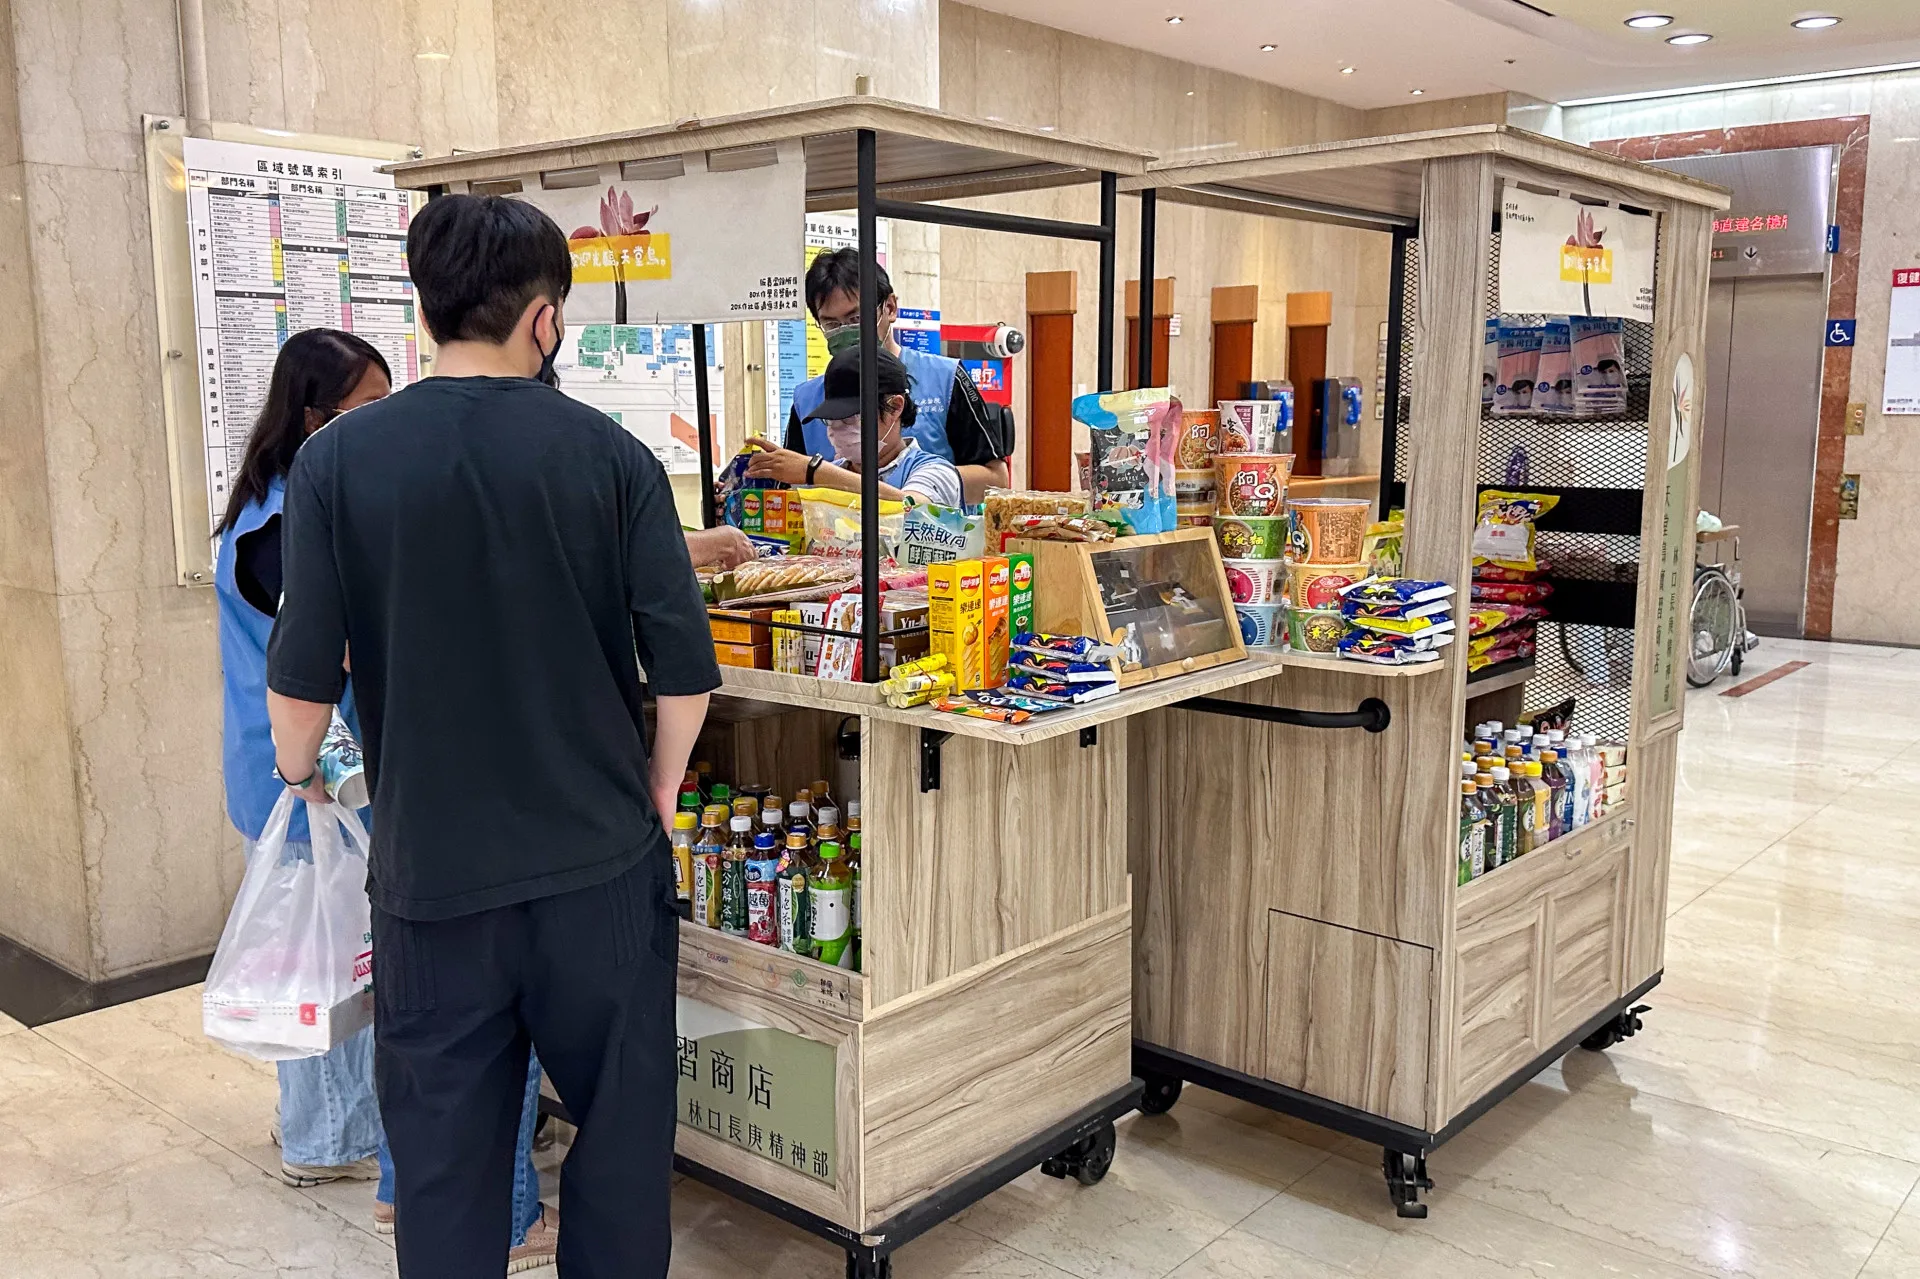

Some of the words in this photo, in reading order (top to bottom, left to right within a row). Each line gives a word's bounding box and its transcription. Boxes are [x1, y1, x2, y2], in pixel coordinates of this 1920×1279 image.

[220, 176, 256, 188] 部門名稱
[257, 160, 343, 180] 區域號碼索引
[290, 183, 323, 195] 部門名稱
[198, 228, 209, 281] 門診部門
[206, 348, 219, 428] 檢查治療部門
[1236, 470, 1276, 500] 阿Q
[903, 520, 967, 549] 天然取向
[1222, 532, 1264, 546] 素食麵
[781, 883, 791, 925] 冷泡茶
[688, 1098, 829, 1178] 林口長庚精神部
